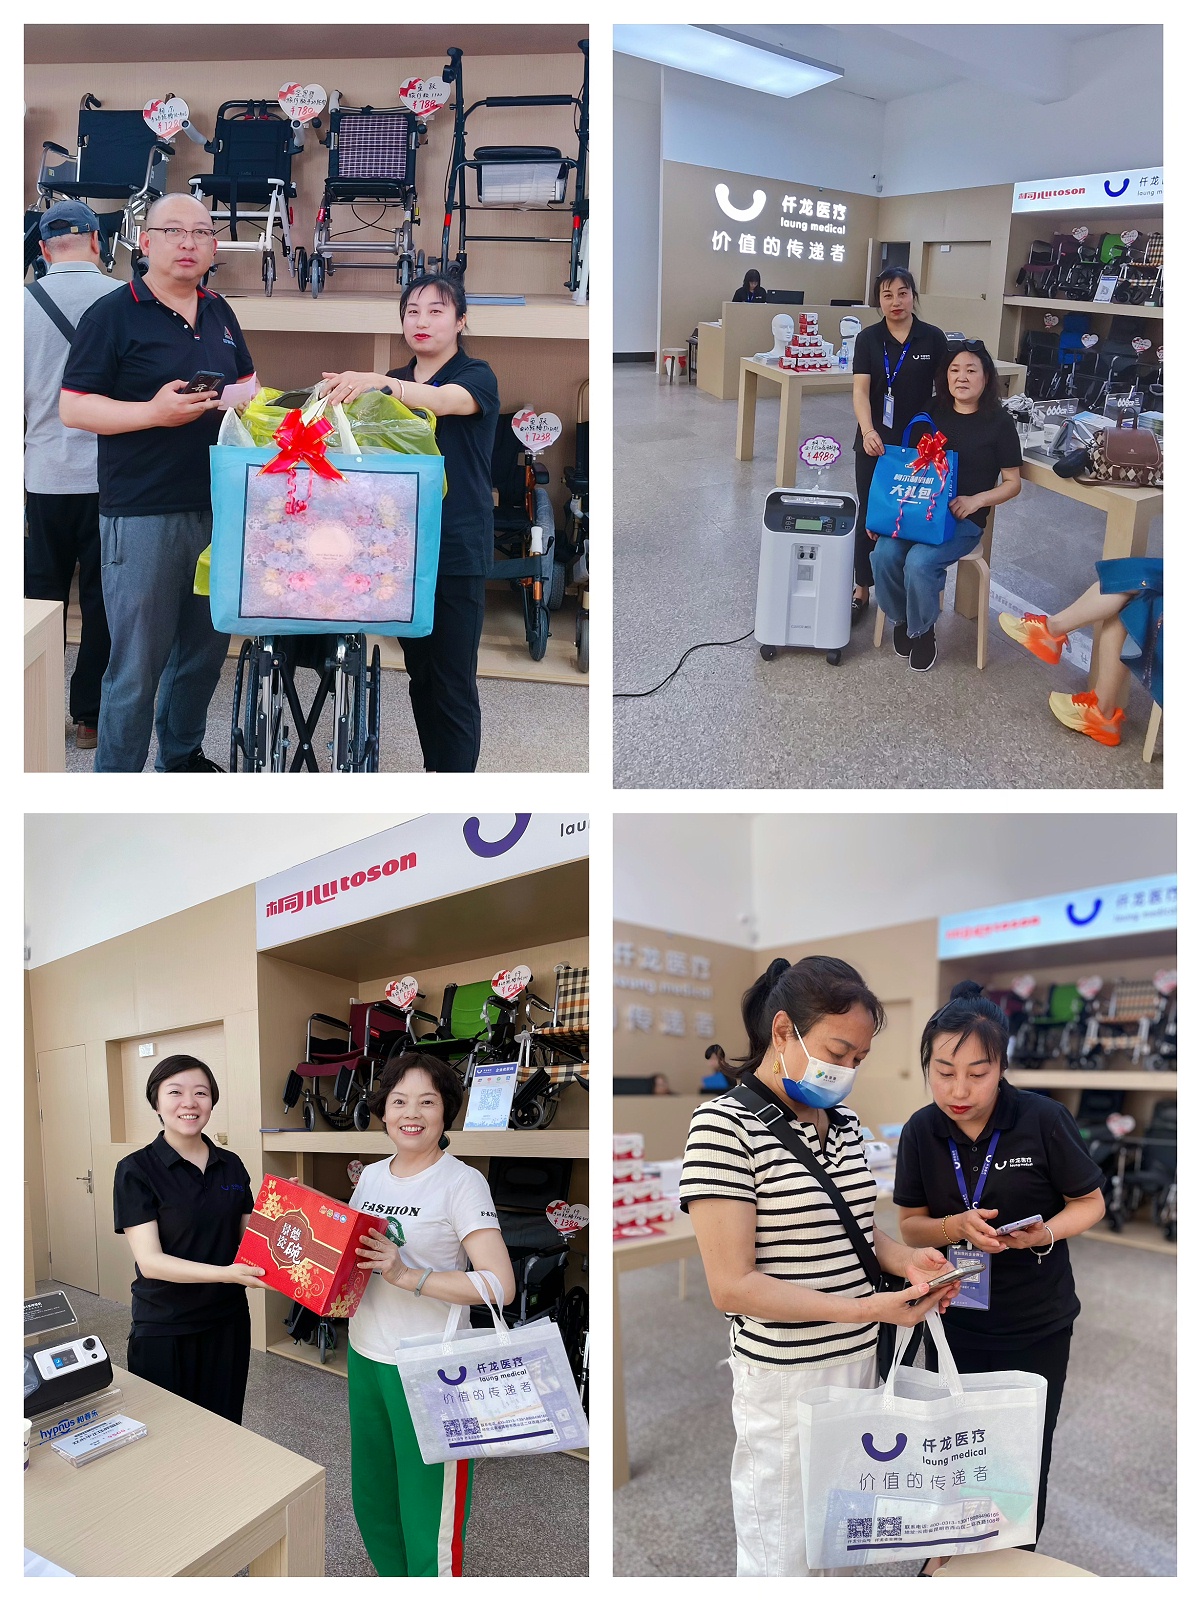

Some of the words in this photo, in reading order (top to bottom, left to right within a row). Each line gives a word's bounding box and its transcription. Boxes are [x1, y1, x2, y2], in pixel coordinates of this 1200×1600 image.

[1053, 187, 1086, 197] toson
[781, 195, 847, 220] 仟龙医疗
[780, 217, 808, 232] laung
[810, 223, 846, 235] medical
[711, 230, 846, 262] 价值的传递者
[889, 484, 932, 499] 大礼包
[560, 820, 589, 837] lau
[341, 851, 417, 892] toson
[361, 1201, 421, 1217] FASHION
[477, 1356, 524, 1374] 仟龙医疗
[479, 1374, 499, 1383] laung
[500, 1368, 527, 1379] medical
[443, 1381, 532, 1404] 价值的传递者
[40, 1418, 75, 1440] hypnus
[922, 1428, 986, 1453] 仟龙医疗
[922, 1456, 949, 1467] laung
[951, 1446, 987, 1463] medical
[859, 1465, 988, 1491] 价值的传递者
